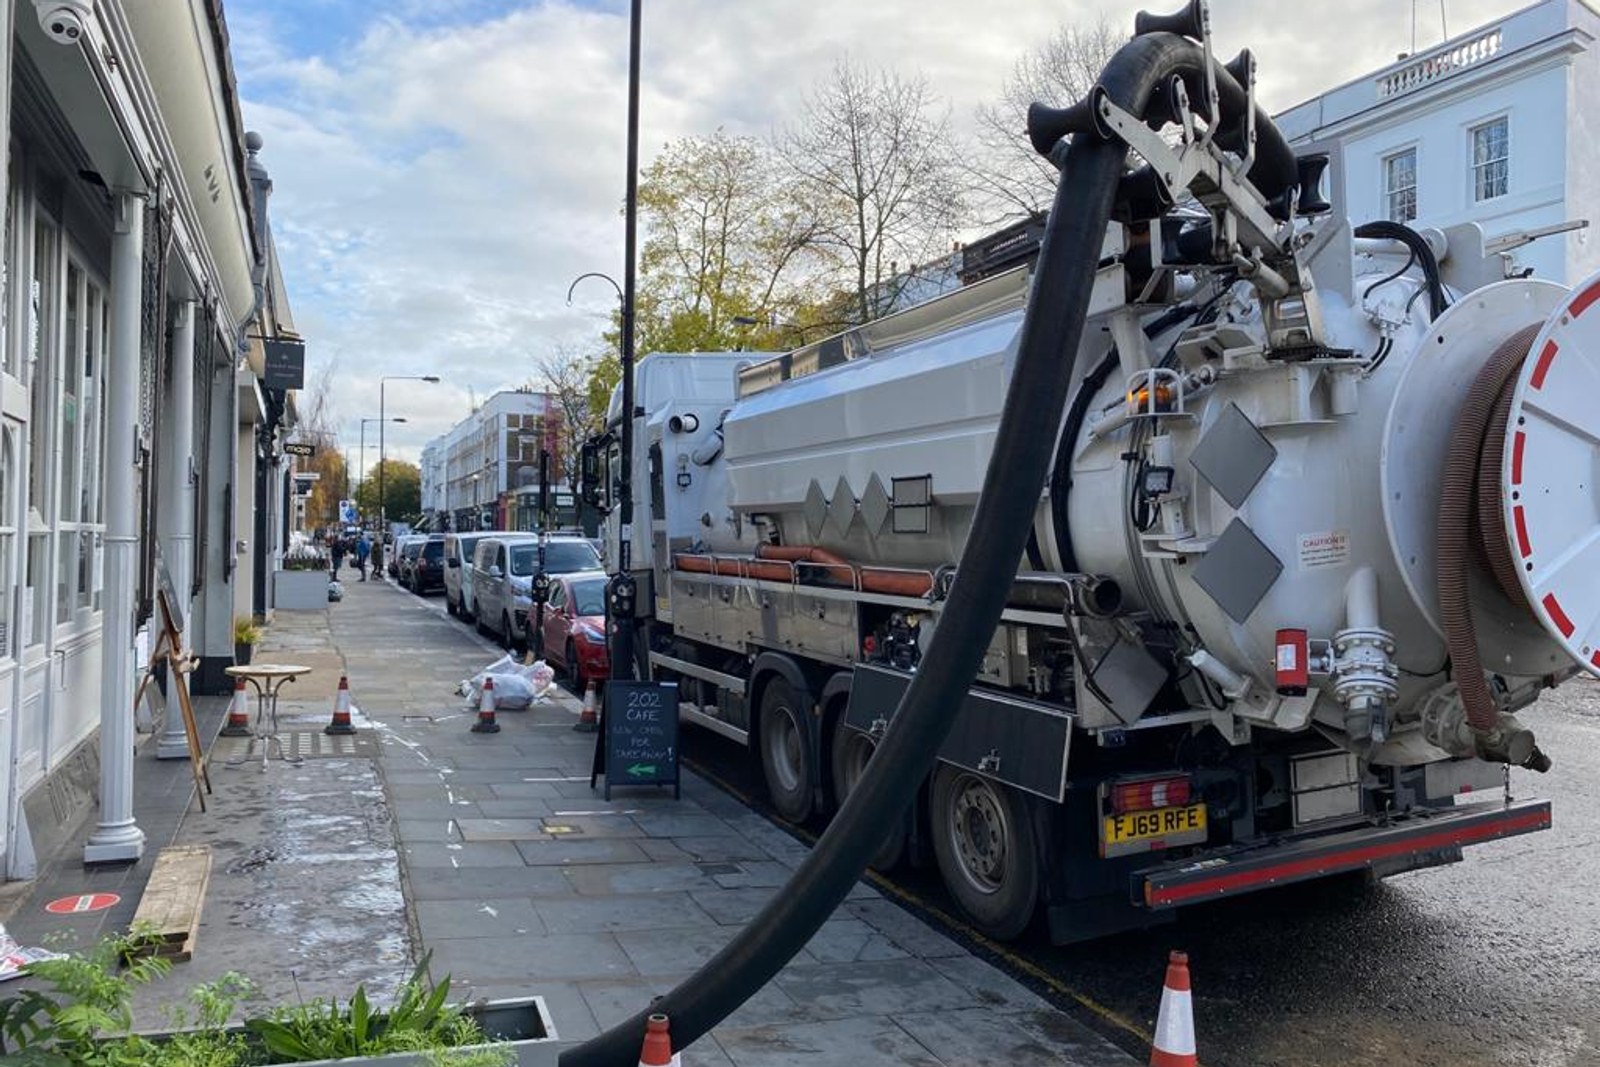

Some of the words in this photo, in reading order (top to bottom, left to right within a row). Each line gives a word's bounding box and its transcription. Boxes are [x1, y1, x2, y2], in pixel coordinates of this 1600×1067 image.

[628, 692, 662, 707] 202
[626, 708, 660, 721] CAFE
[1113, 813, 1159, 840] FJ69
[1165, 808, 1199, 831] RFE
